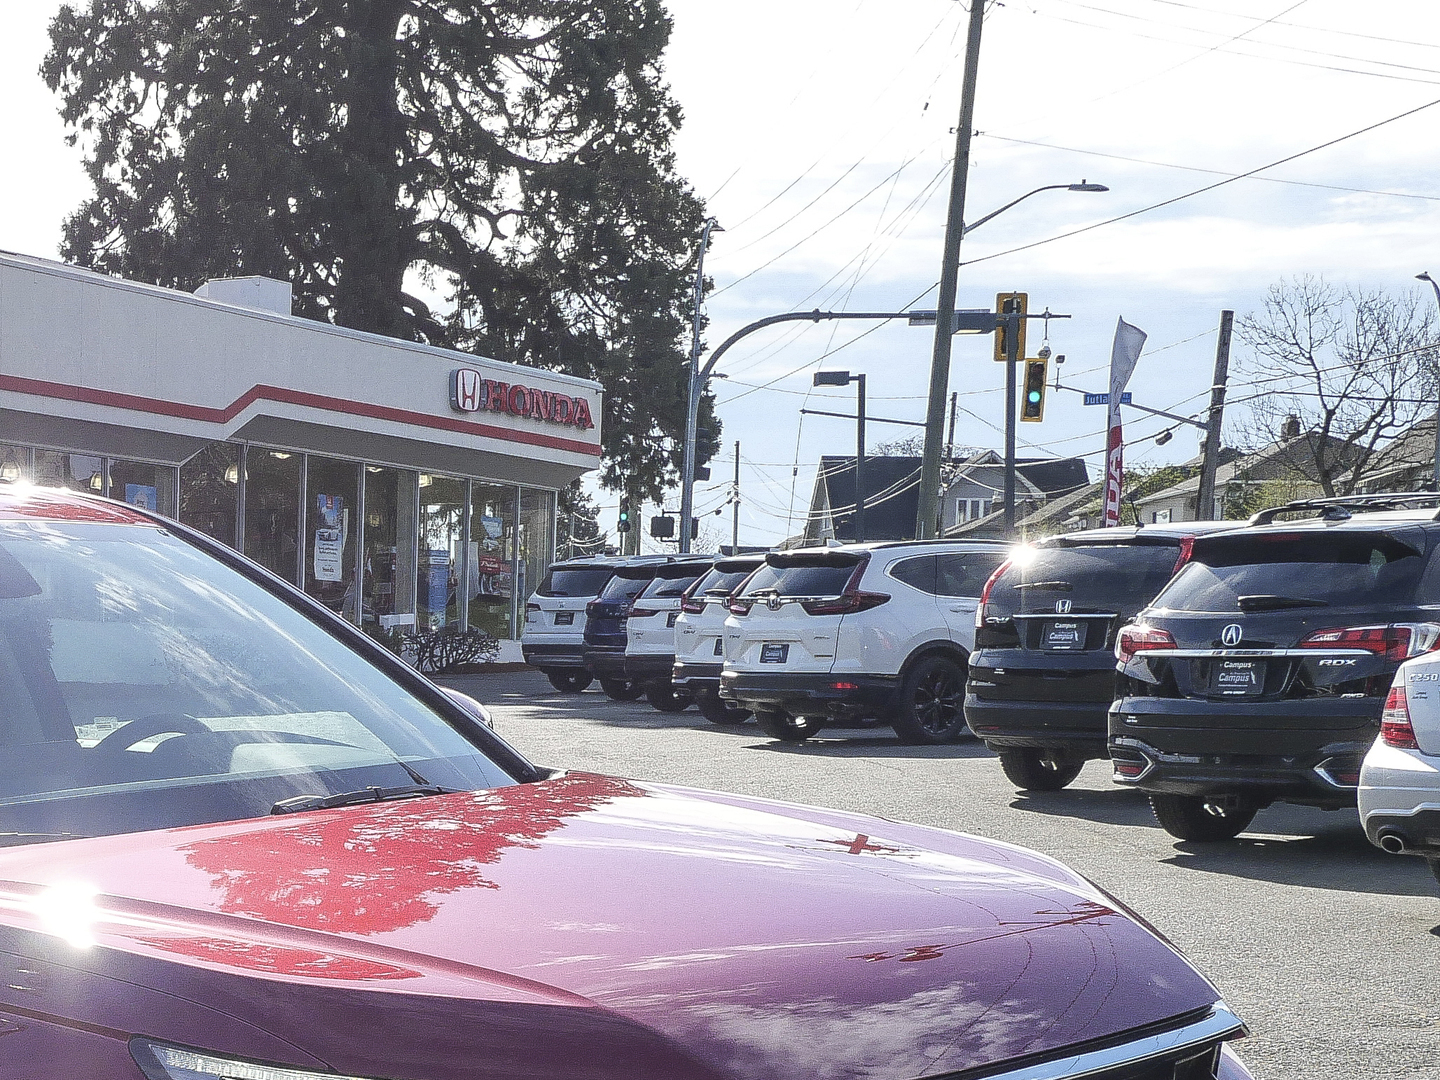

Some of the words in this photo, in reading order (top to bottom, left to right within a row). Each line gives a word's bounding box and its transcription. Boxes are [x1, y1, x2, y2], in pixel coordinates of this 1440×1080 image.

[484, 378, 595, 430] HONDA
[1223, 661, 1252, 670] Campus
[1319, 659, 1357, 667] RDX
[1218, 672, 1250, 684] Campus
